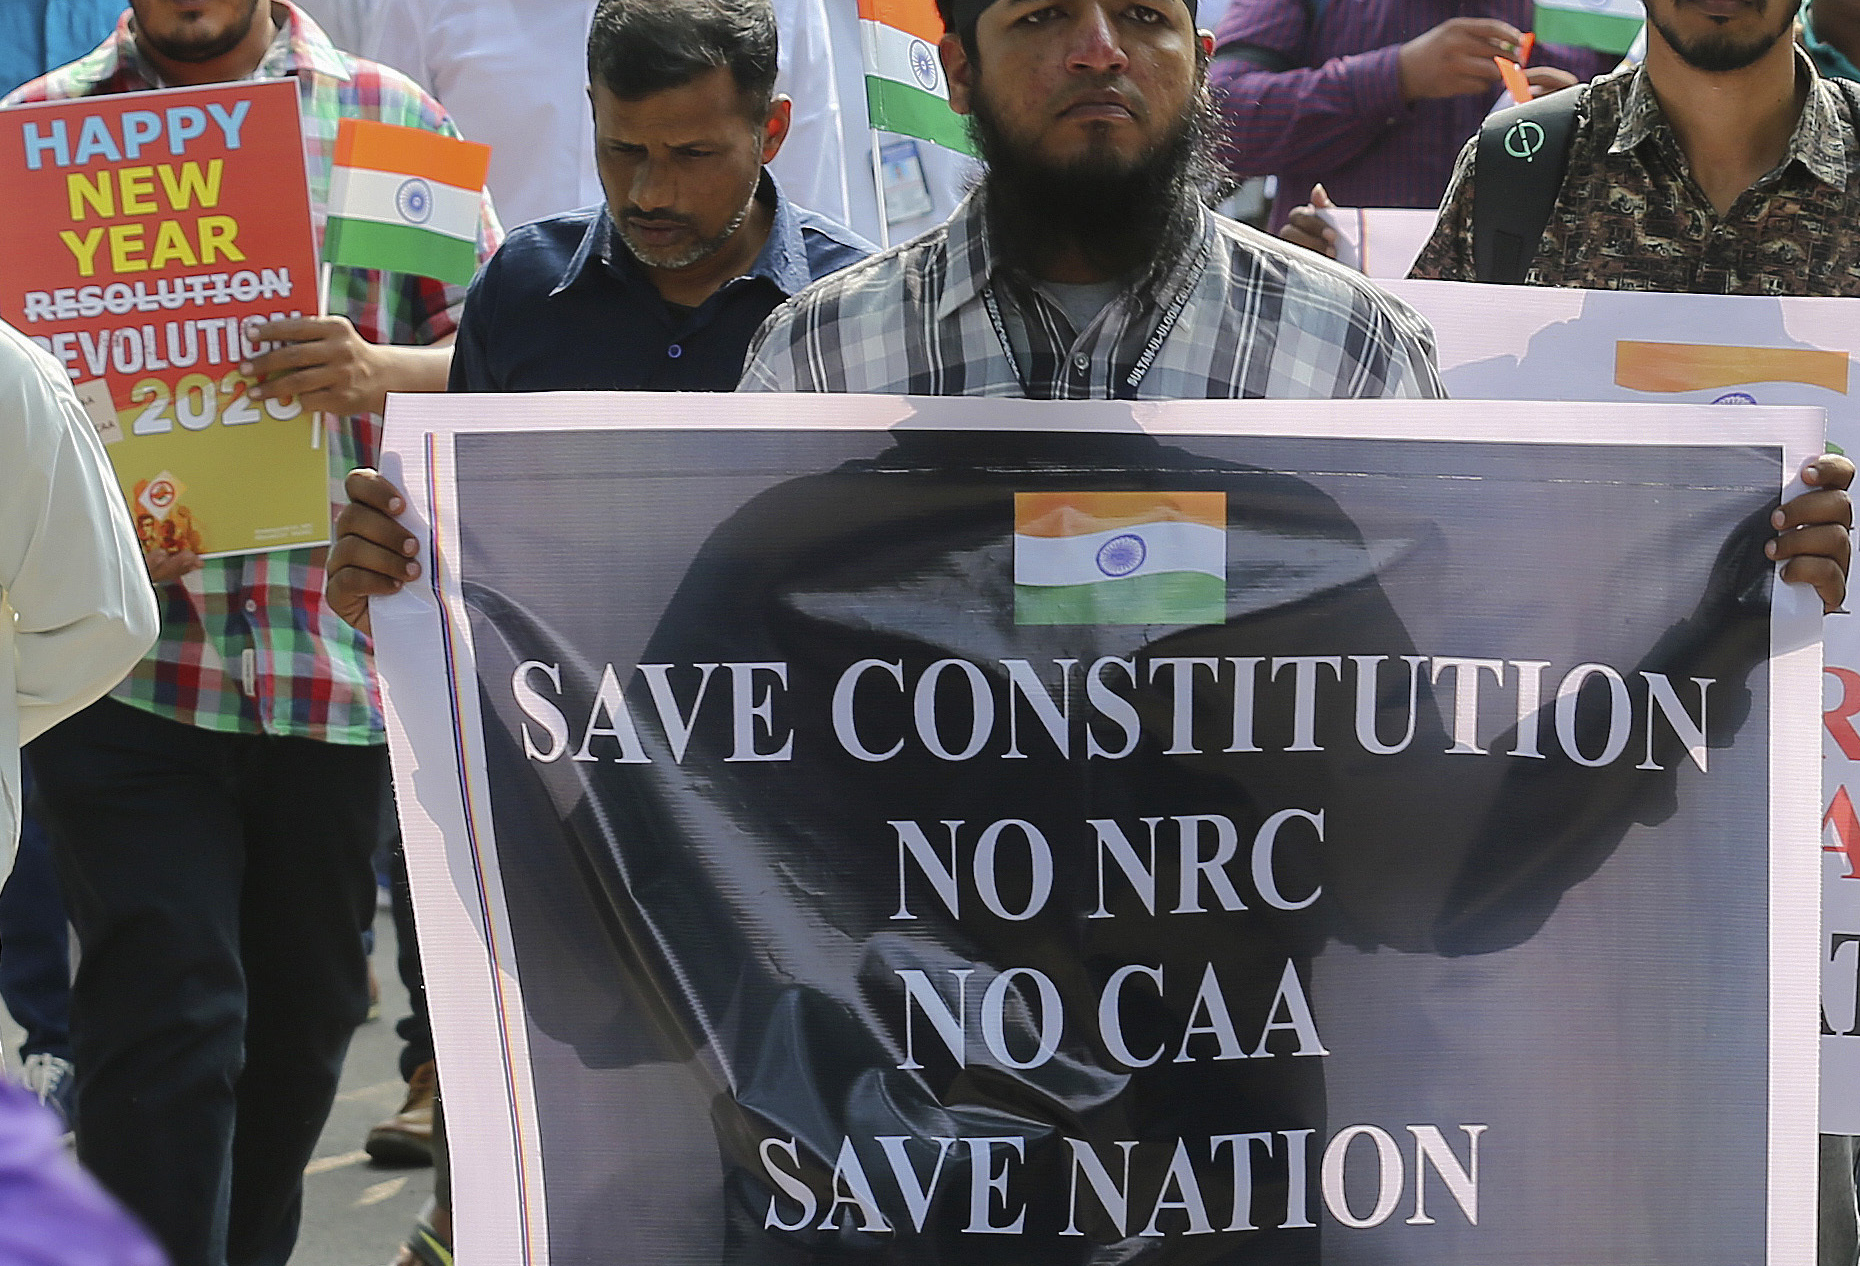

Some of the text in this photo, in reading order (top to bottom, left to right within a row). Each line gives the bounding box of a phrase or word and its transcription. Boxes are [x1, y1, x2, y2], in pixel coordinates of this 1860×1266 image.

[22, 100, 251, 170] HAPPY
[66, 158, 224, 221] NEW
[59, 215, 246, 277] YEAR
[23, 267, 293, 323] RESOLUTION
[510, 655, 1717, 773] SAVE CONSTITUTION
[887, 807, 1326, 921] NO NRC
[893, 957, 1330, 1070] NO CAA
[758, 1123, 1488, 1238] SAVE NATION
